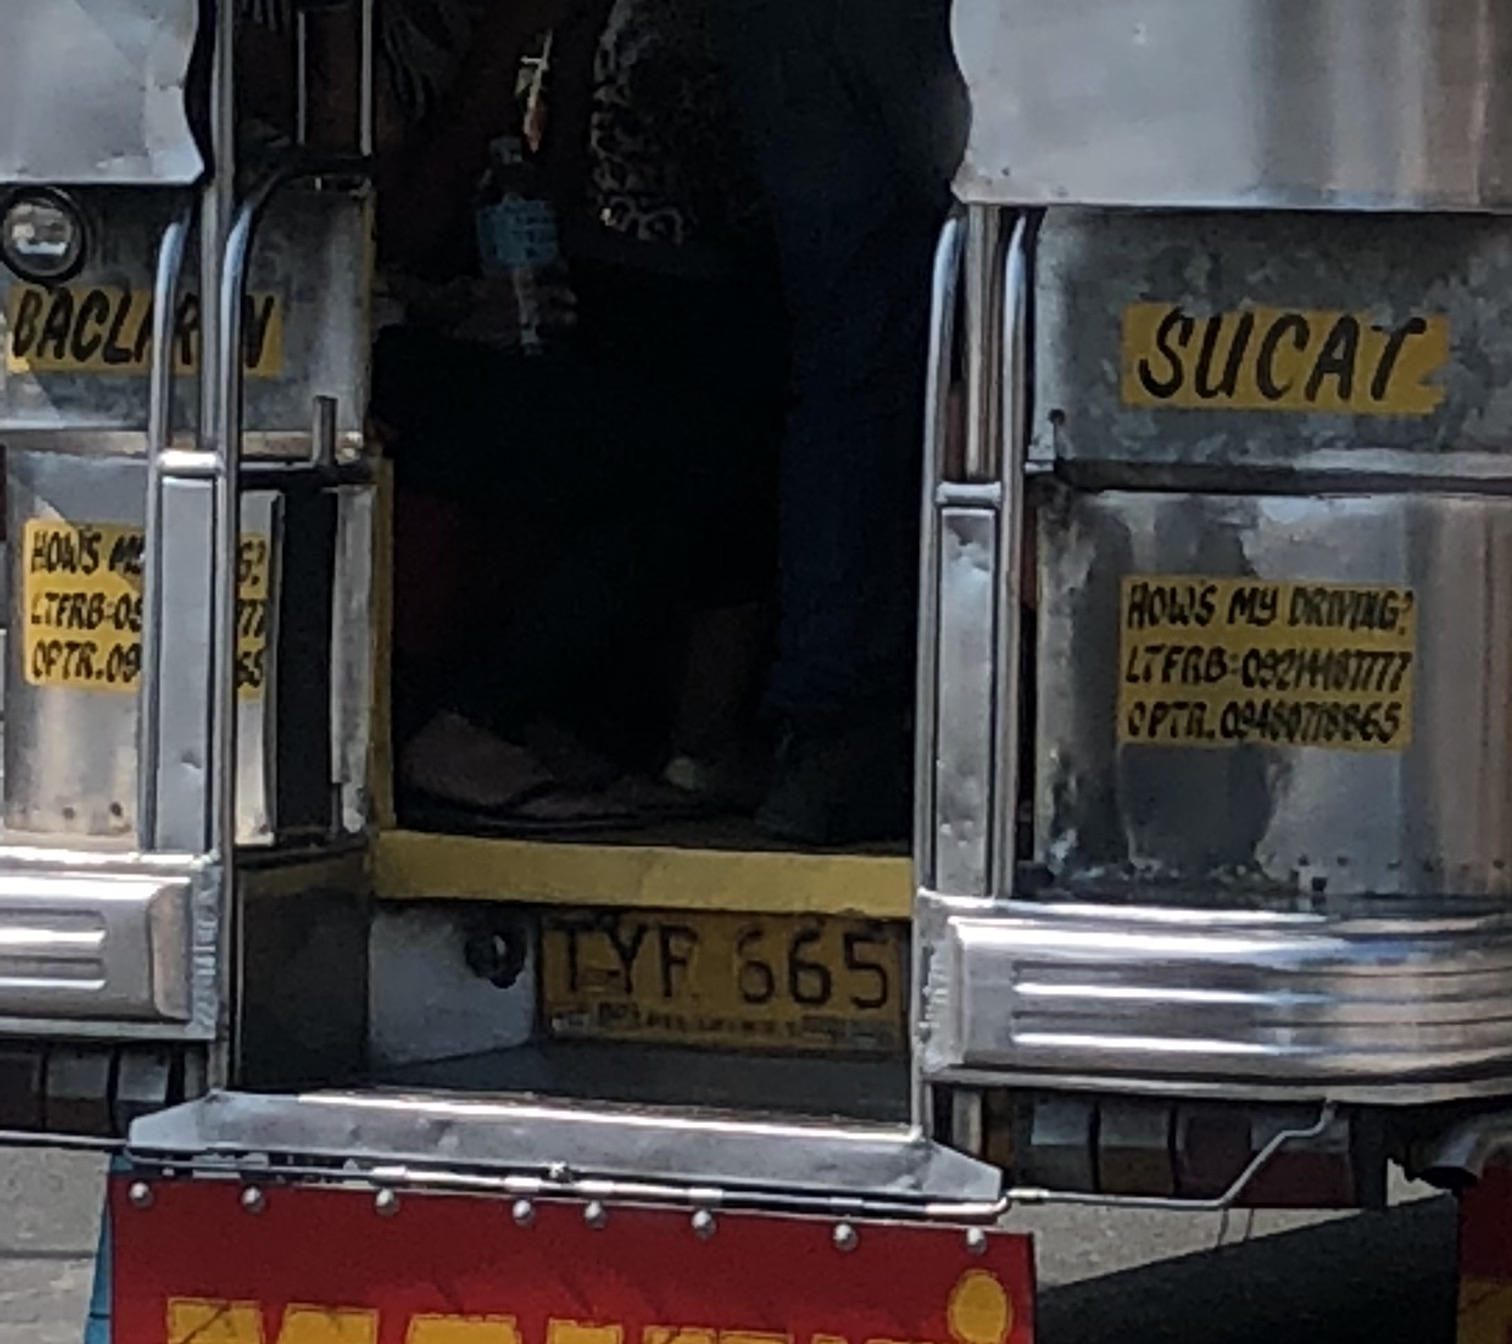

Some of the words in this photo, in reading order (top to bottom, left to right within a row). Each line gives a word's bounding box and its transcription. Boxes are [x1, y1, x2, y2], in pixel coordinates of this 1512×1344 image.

[12, 287, 275, 369] BACLRN
[1138, 306, 1428, 402] SUCAT
[735, 918, 888, 1010] 665
